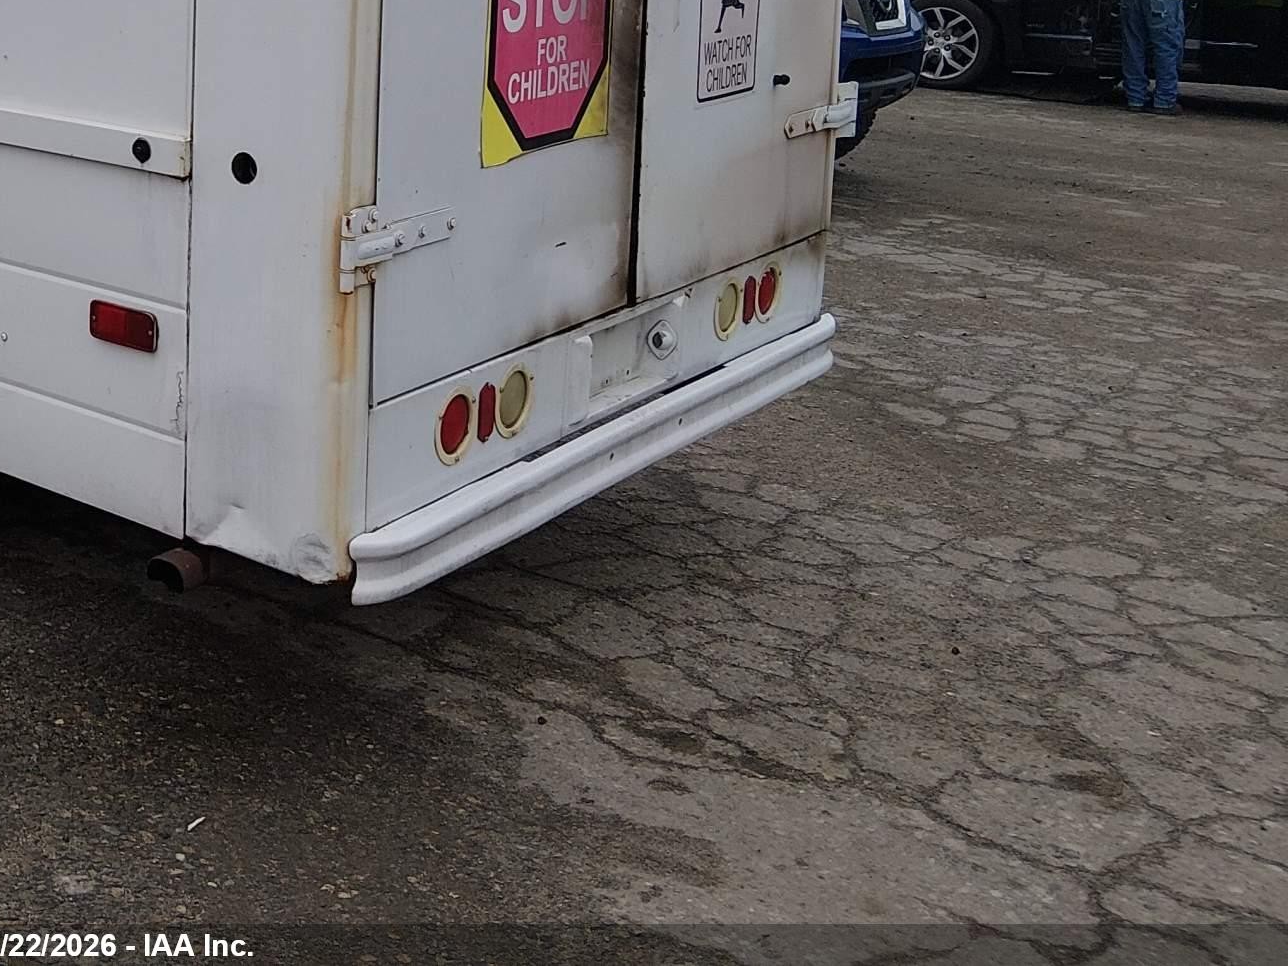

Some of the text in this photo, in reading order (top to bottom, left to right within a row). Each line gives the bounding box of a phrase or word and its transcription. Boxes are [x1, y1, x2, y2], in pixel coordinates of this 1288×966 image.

[537, 35, 567, 66] FOR
[704, 34, 752, 65] WATCH FOR
[507, 59, 591, 105] CHILDREN
[706, 61, 748, 93] CHILDREN
